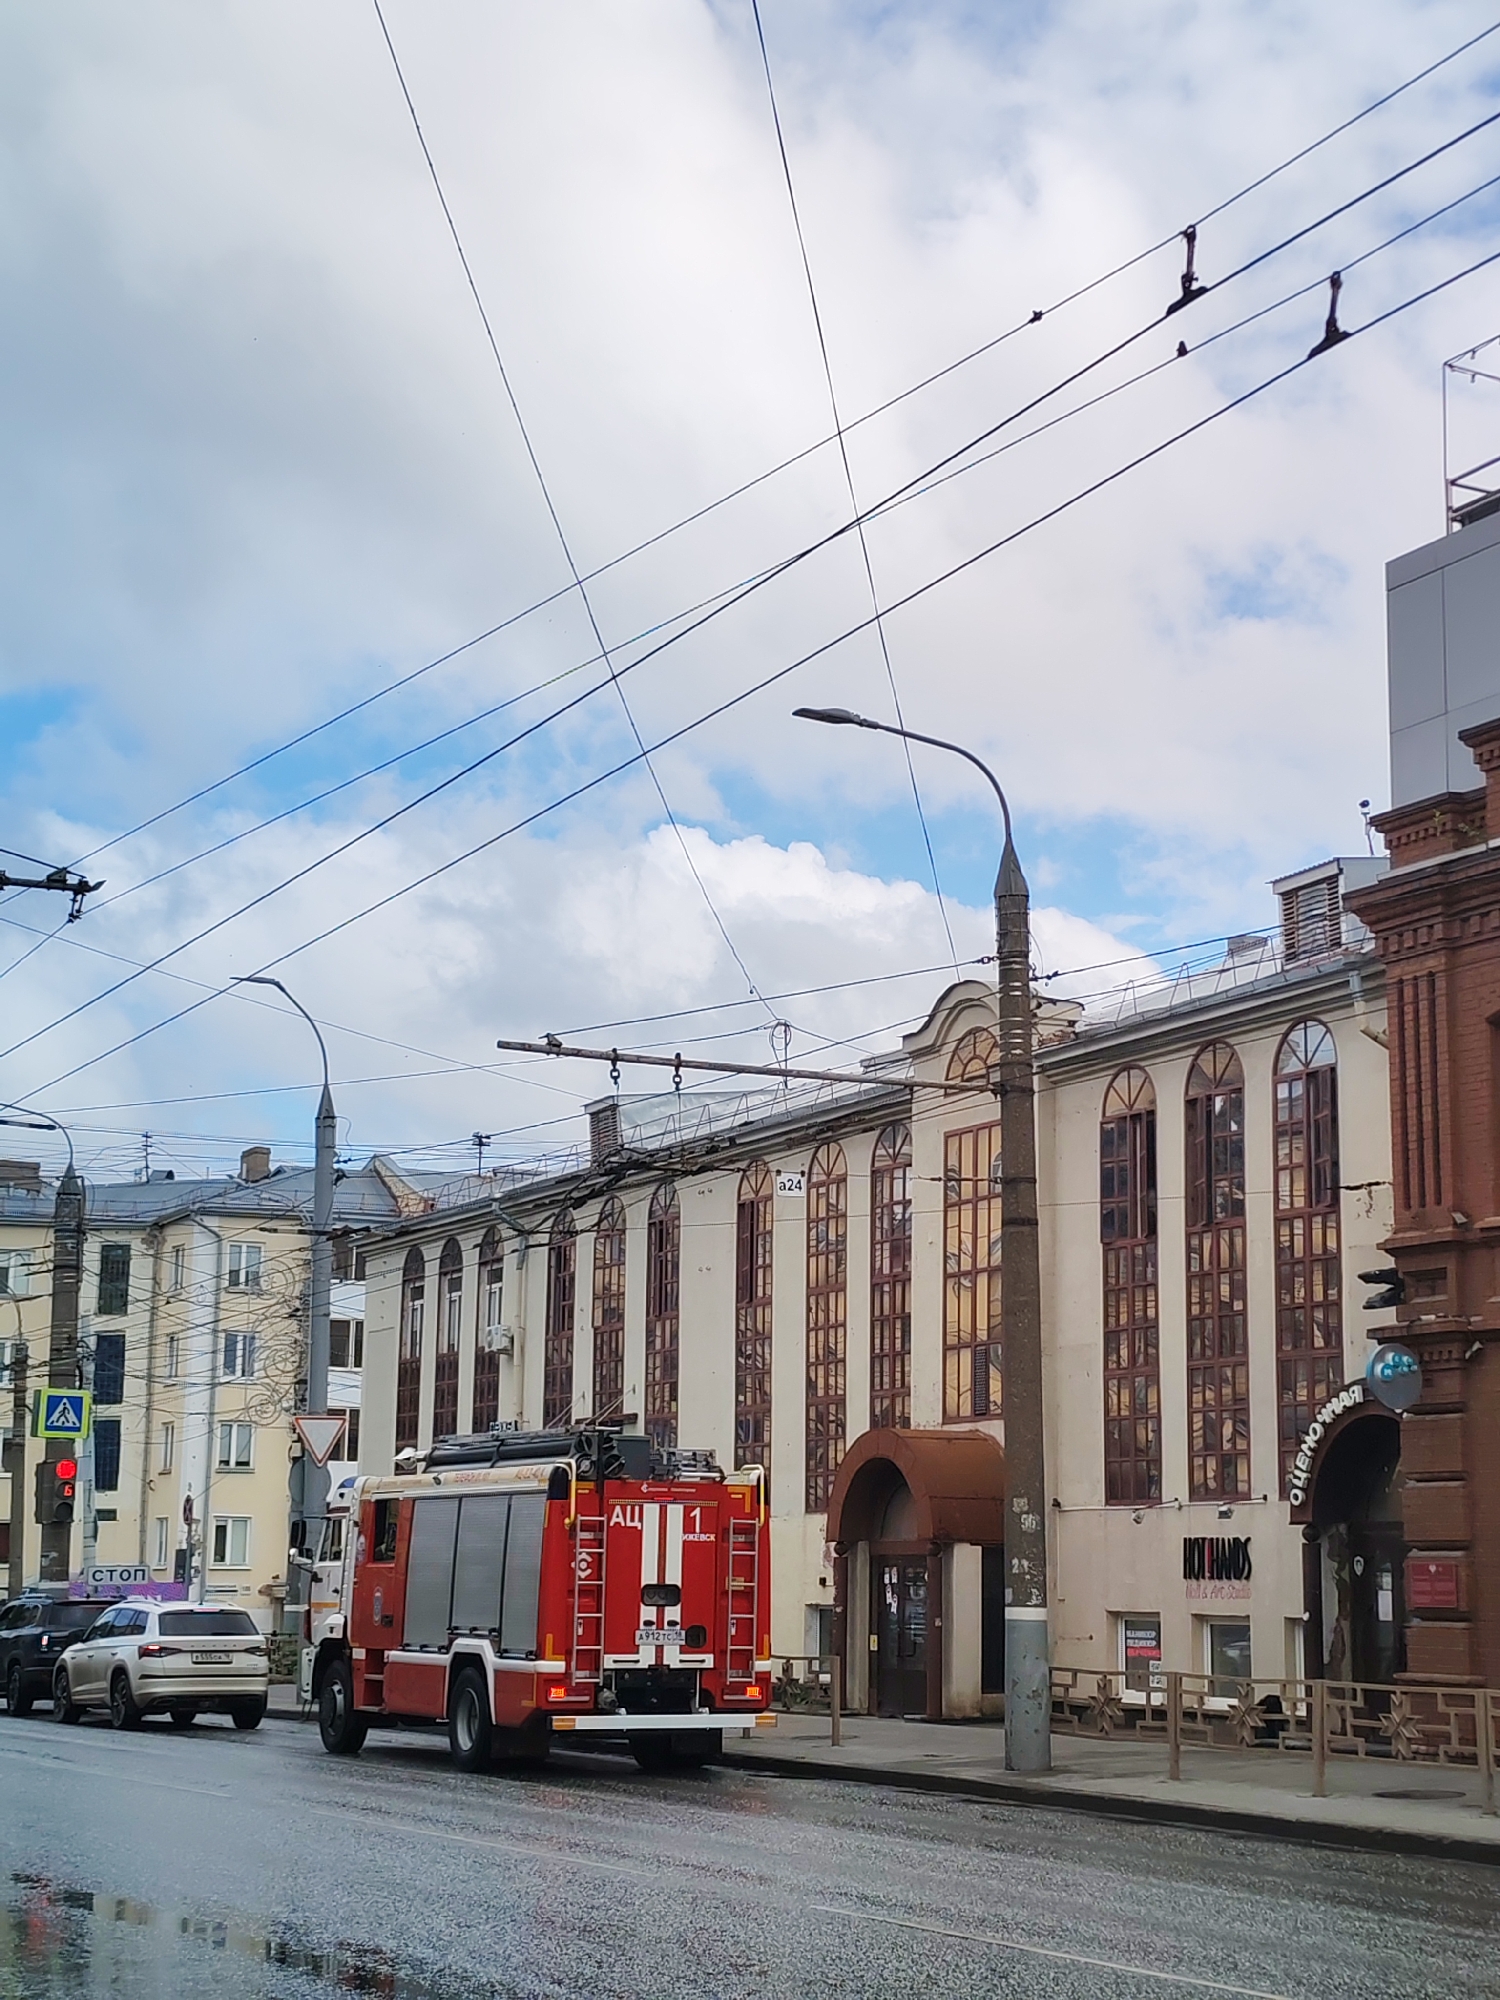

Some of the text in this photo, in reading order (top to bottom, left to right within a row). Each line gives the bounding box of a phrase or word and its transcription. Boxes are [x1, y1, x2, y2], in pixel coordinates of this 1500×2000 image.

[609, 1505, 701, 1534] АЦ 1
[91, 1568, 147, 1582] СТОП
